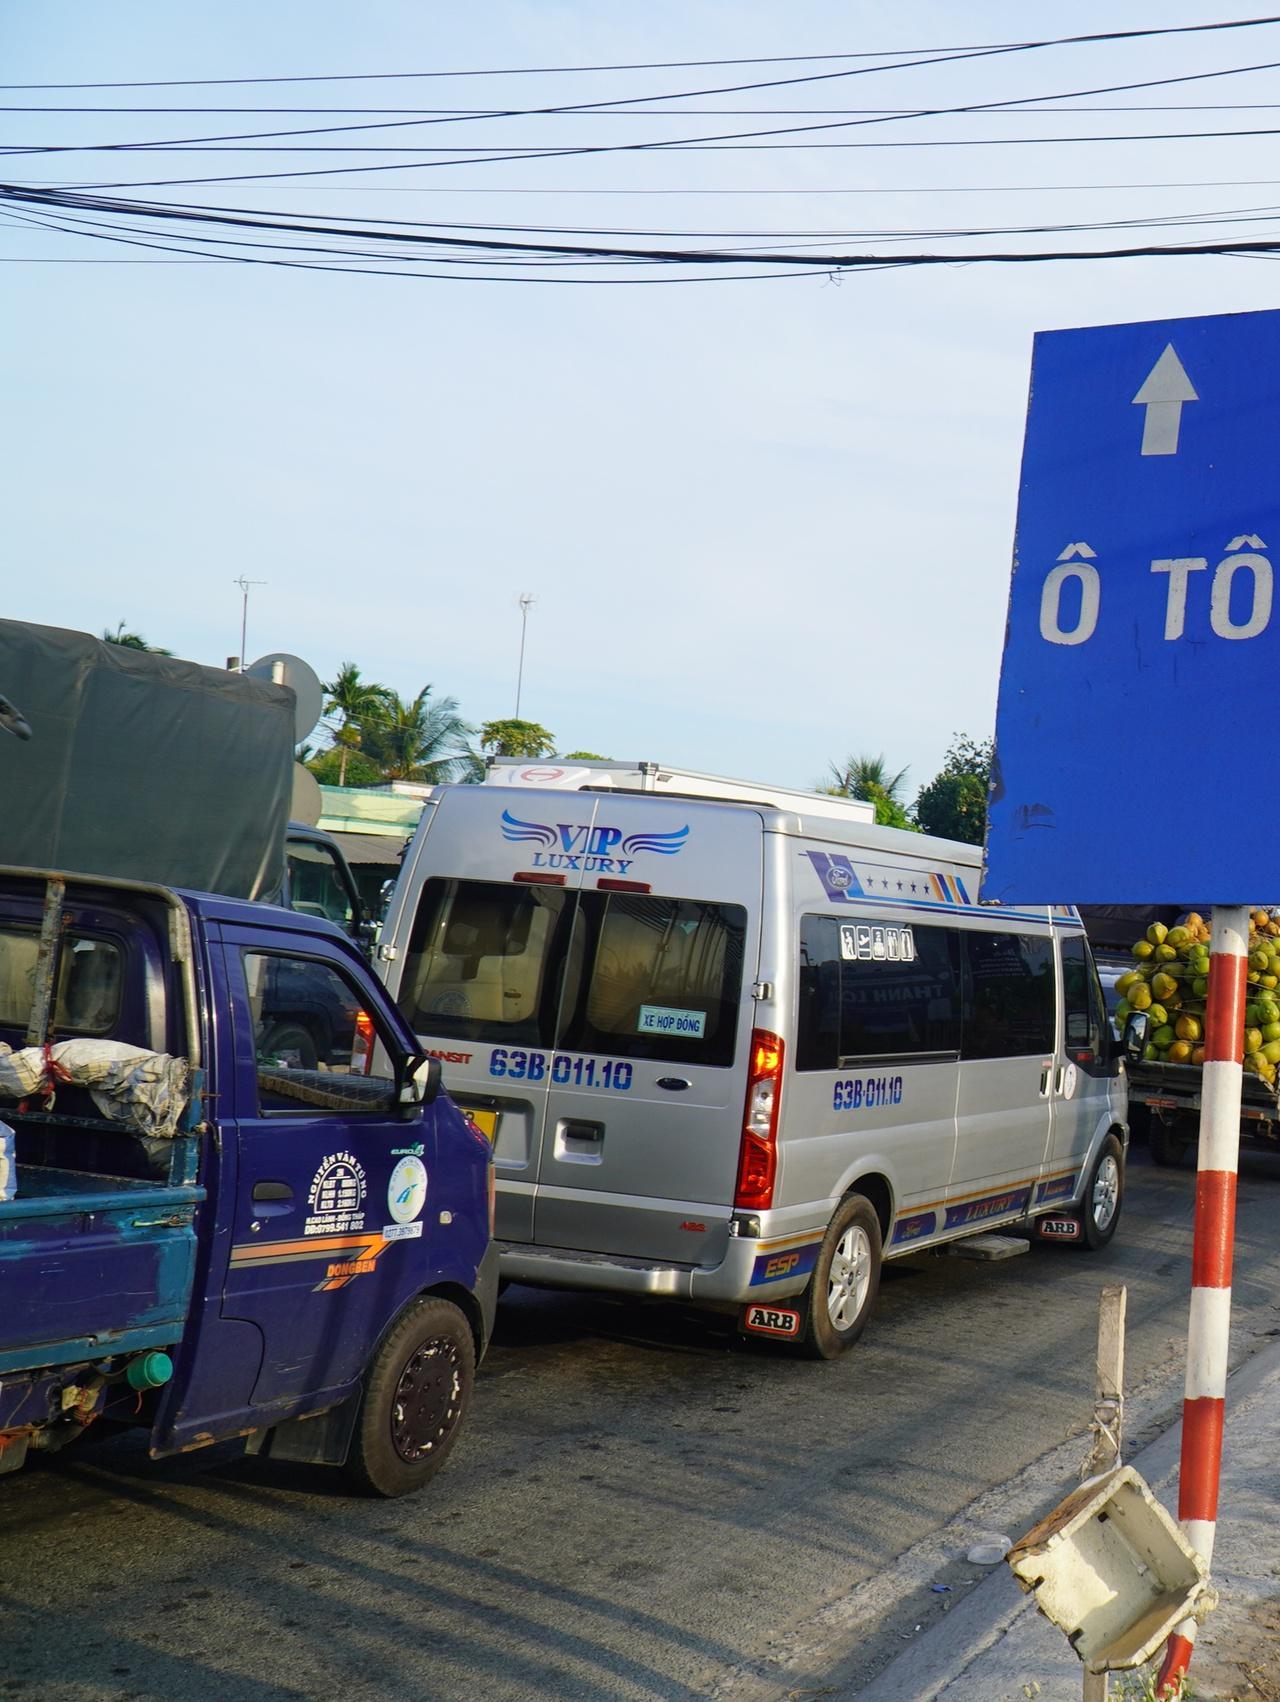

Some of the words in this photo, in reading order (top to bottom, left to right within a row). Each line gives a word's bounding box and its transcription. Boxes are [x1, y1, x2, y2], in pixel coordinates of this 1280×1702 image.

[1039, 542, 1100, 645] Ô
[1150, 533, 1274, 641] TÔ
[556, 824, 622, 856] VIP
[532, 852, 633, 874] LUXURY
[643, 1014, 656, 1027] XE
[657, 1014, 675, 1030] HỢP
[676, 1014, 701, 1033] ĐỒNG
[965, 1194, 1016, 1222] LUXURY
[1041, 1219, 1076, 1236] ARB
[327, 1258, 377, 1278] DONGBEN
[765, 1254, 800, 1279] ESP
[749, 1309, 795, 1333] ARB
